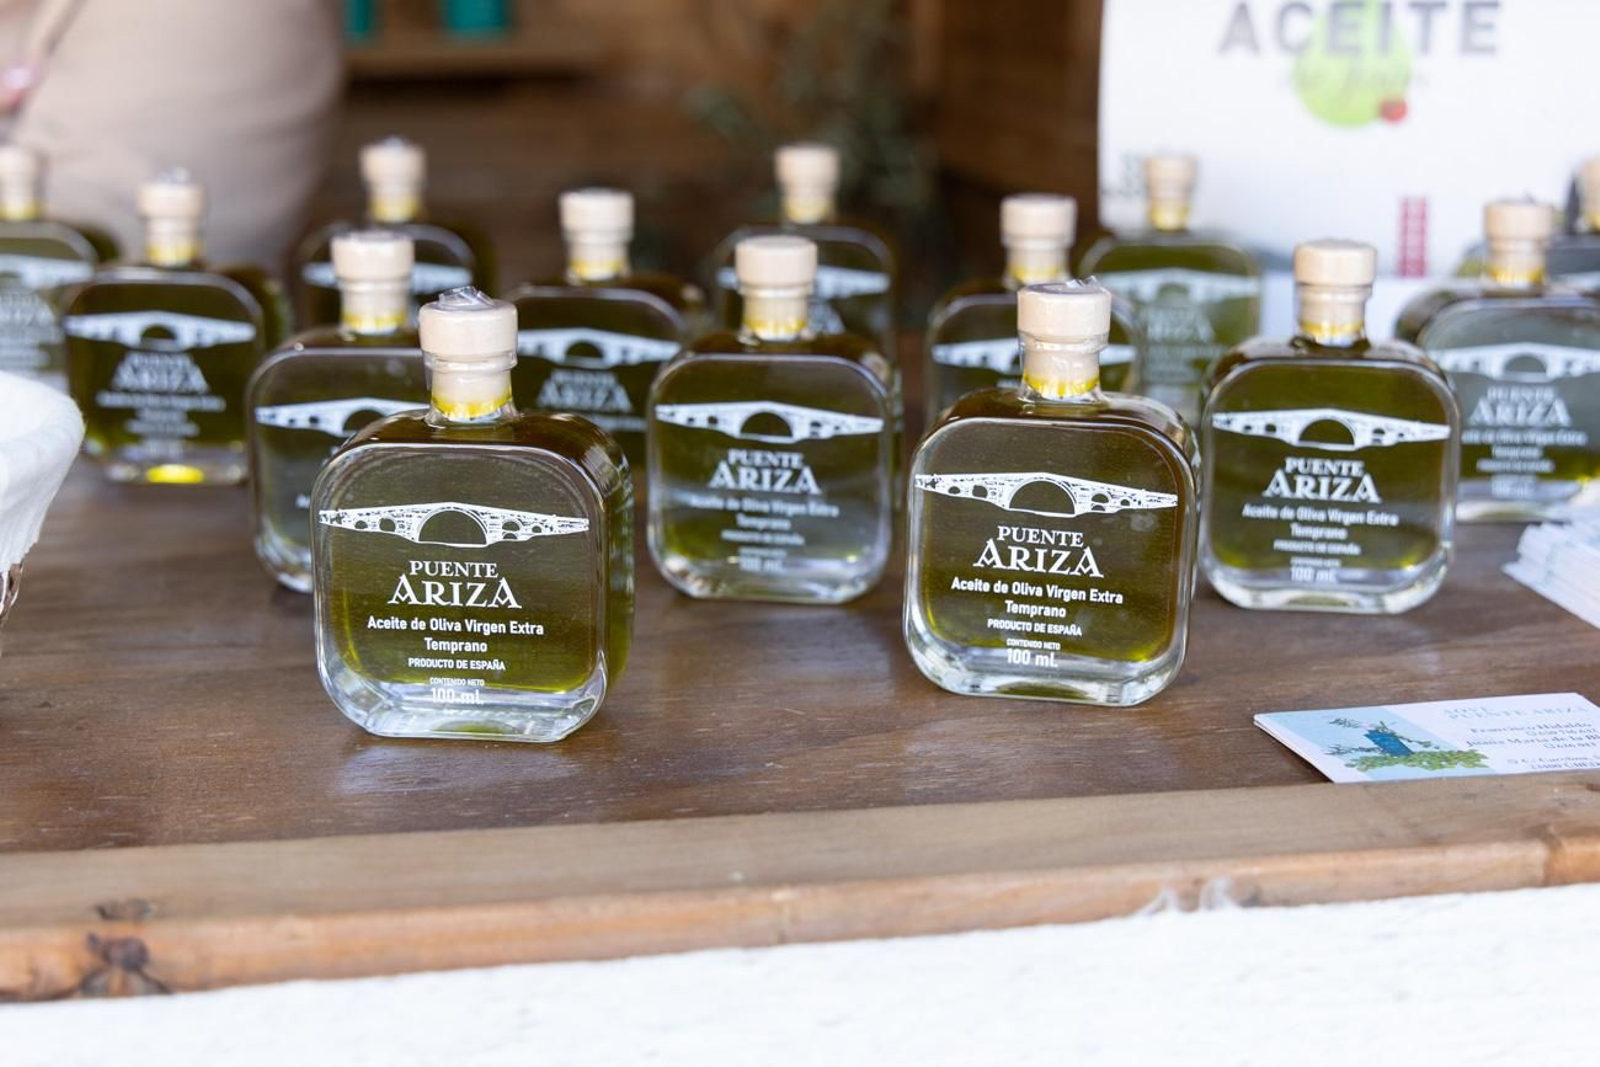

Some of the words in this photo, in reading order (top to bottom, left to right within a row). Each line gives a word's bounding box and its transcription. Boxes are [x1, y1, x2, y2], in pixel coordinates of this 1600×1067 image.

[1216, 0, 1500, 56] ACEITE
[1469, 398, 1572, 427] ARIZA
[728, 448, 804, 469] PUENTE
[1285, 457, 1365, 478] PUENTE
[708, 461, 822, 495] ARIZA
[1262, 469, 1382, 504] ARIZA
[1242, 503, 1278, 519] Aceite
[1280, 506, 1295, 520] de
[1297, 506, 1326, 523] Oliva
[1328, 508, 1364, 527] Virgen
[1366, 511, 1399, 526] Extra
[997, 526, 1084, 547] PUENTE
[1290, 522, 1348, 540] Temprano
[409, 560, 498, 578] PUENTE
[973, 538, 1104, 579] ARIZA
[1291, 566, 1315, 581] 100
[387, 573, 522, 609] ARIZA
[951, 576, 990, 593] Aceite
[993, 580, 1009, 594] de
[1012, 581, 1043, 598] Oliva
[1046, 584, 1086, 602] Virgen
[1089, 588, 1123, 604] Extra
[1005, 600, 1066, 618] Temprano
[367, 615, 407, 630] Aceite
[411, 617, 426, 631] de
[430, 618, 462, 632] Oliva
[464, 619, 506, 636] Virgen
[510, 621, 544, 635] Extra
[987, 618, 1032, 632] PRODUCTO
[1034, 622, 1046, 633] DE
[1047, 623, 1083, 637] ESPAÑA
[424, 637, 488, 654] Temprano
[1006, 638, 1042, 649] CONTENIDO
[1043, 641, 1061, 651] NETO
[408, 657, 454, 669] PRODUCTO
[456, 659, 468, 669] DE
[470, 659, 506, 670] ESPAÑA
[1007, 648, 1031, 665] 100
[430, 677, 466, 687] CONTENIDO
[467, 678, 485, 687] NETO
[431, 687, 455, 703] 100
